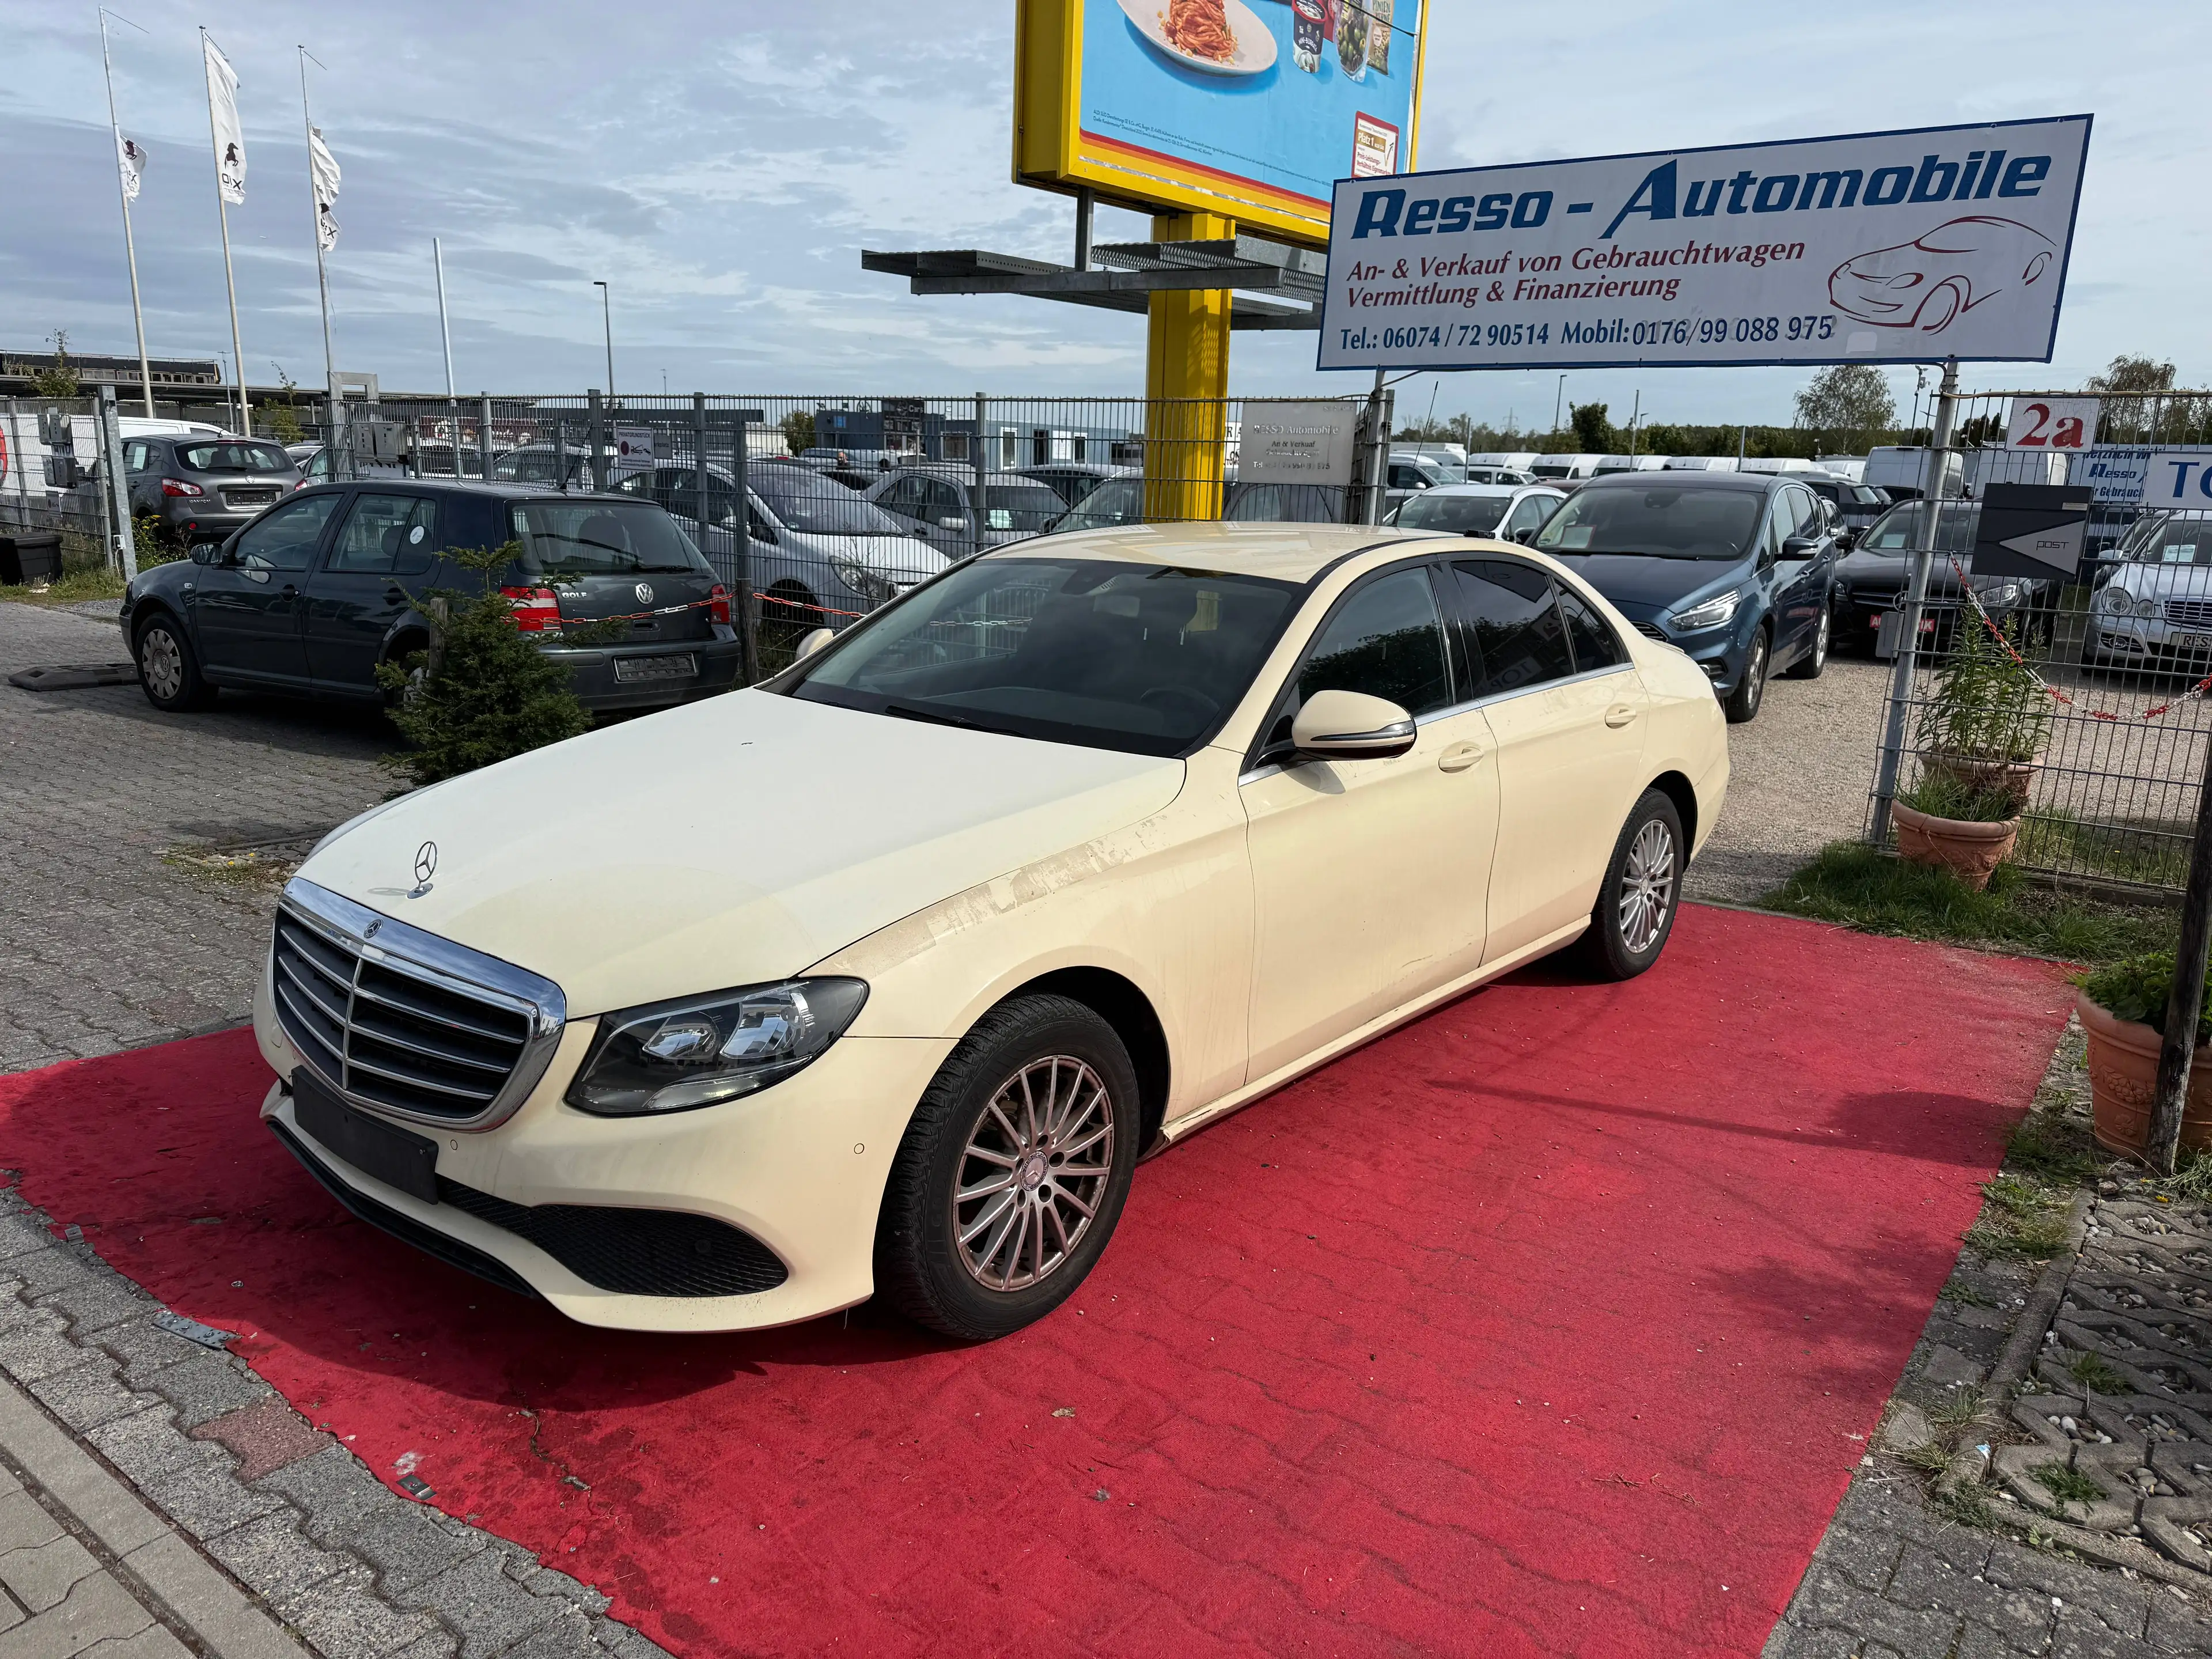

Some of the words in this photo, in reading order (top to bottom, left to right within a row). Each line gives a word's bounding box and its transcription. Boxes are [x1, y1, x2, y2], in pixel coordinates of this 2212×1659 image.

[1350, 189, 1554, 240] Resso
[1566, 202, 1594, 214] -
[1597, 150, 2052, 240] Automobile
[1346, 261, 1385, 282] An-
[1392, 258, 1410, 279] &
[1421, 250, 1513, 278] Verkauf
[1518, 255, 1562, 273] von
[1571, 240, 1805, 270] Gebrauchtwagen
[1348, 281, 1480, 309] Vermittlung
[1486, 281, 1505, 302] &
[1512, 277, 1682, 302] Finanzierung
[1340, 325, 1378, 351] Tel.:
[1382, 325, 1441, 349] 06074
[1457, 324, 1482, 346] 72
[1487, 323, 1549, 347] 90514
[1560, 317, 1630, 344] Mobil:
[1633, 317, 1728, 346] 0176/99
[1736, 316, 1779, 343] 088
[1784, 314, 1838, 341] 975
[1286, 425, 1339, 435] Automobile
[2016, 403, 2084, 449] 2a
[2088, 463, 2137, 479] Resso
